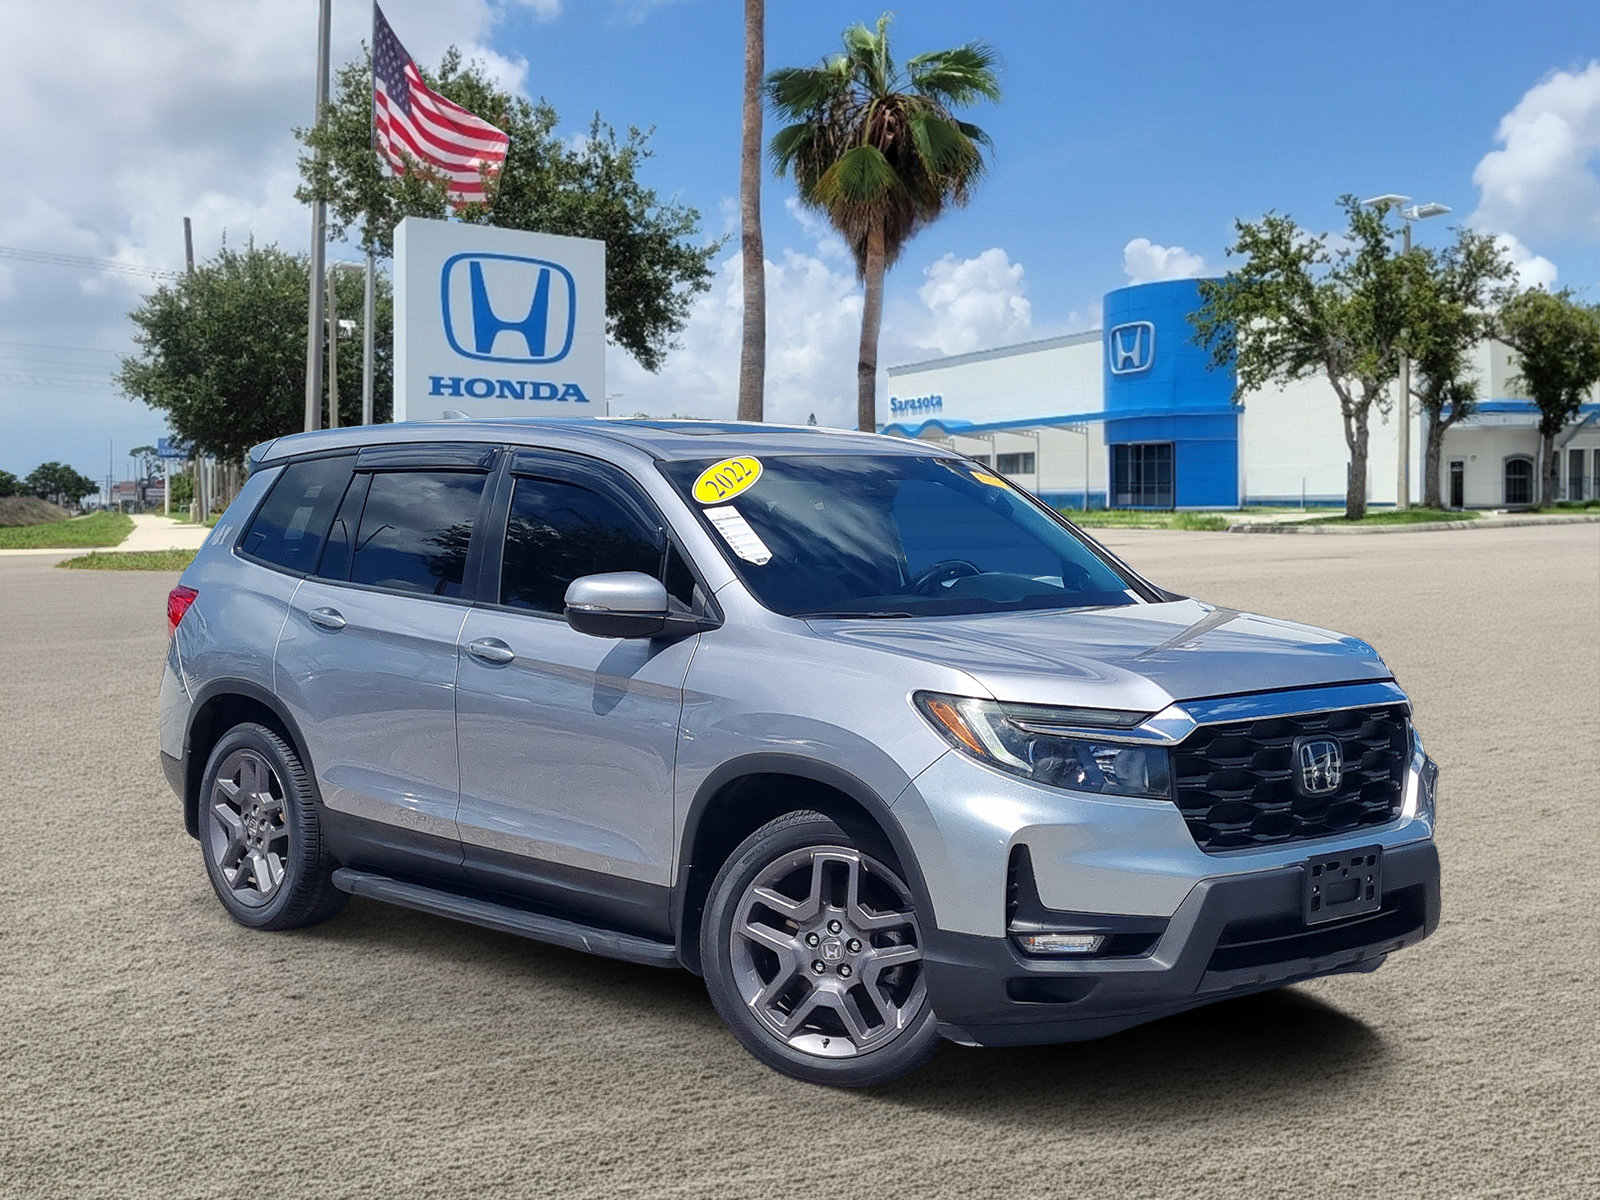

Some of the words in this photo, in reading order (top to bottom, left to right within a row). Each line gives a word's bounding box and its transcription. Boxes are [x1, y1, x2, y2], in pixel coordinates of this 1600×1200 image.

[428, 375, 590, 403] HONDA
[890, 394, 943, 412] Sarasota
[705, 461, 752, 497] 2022
